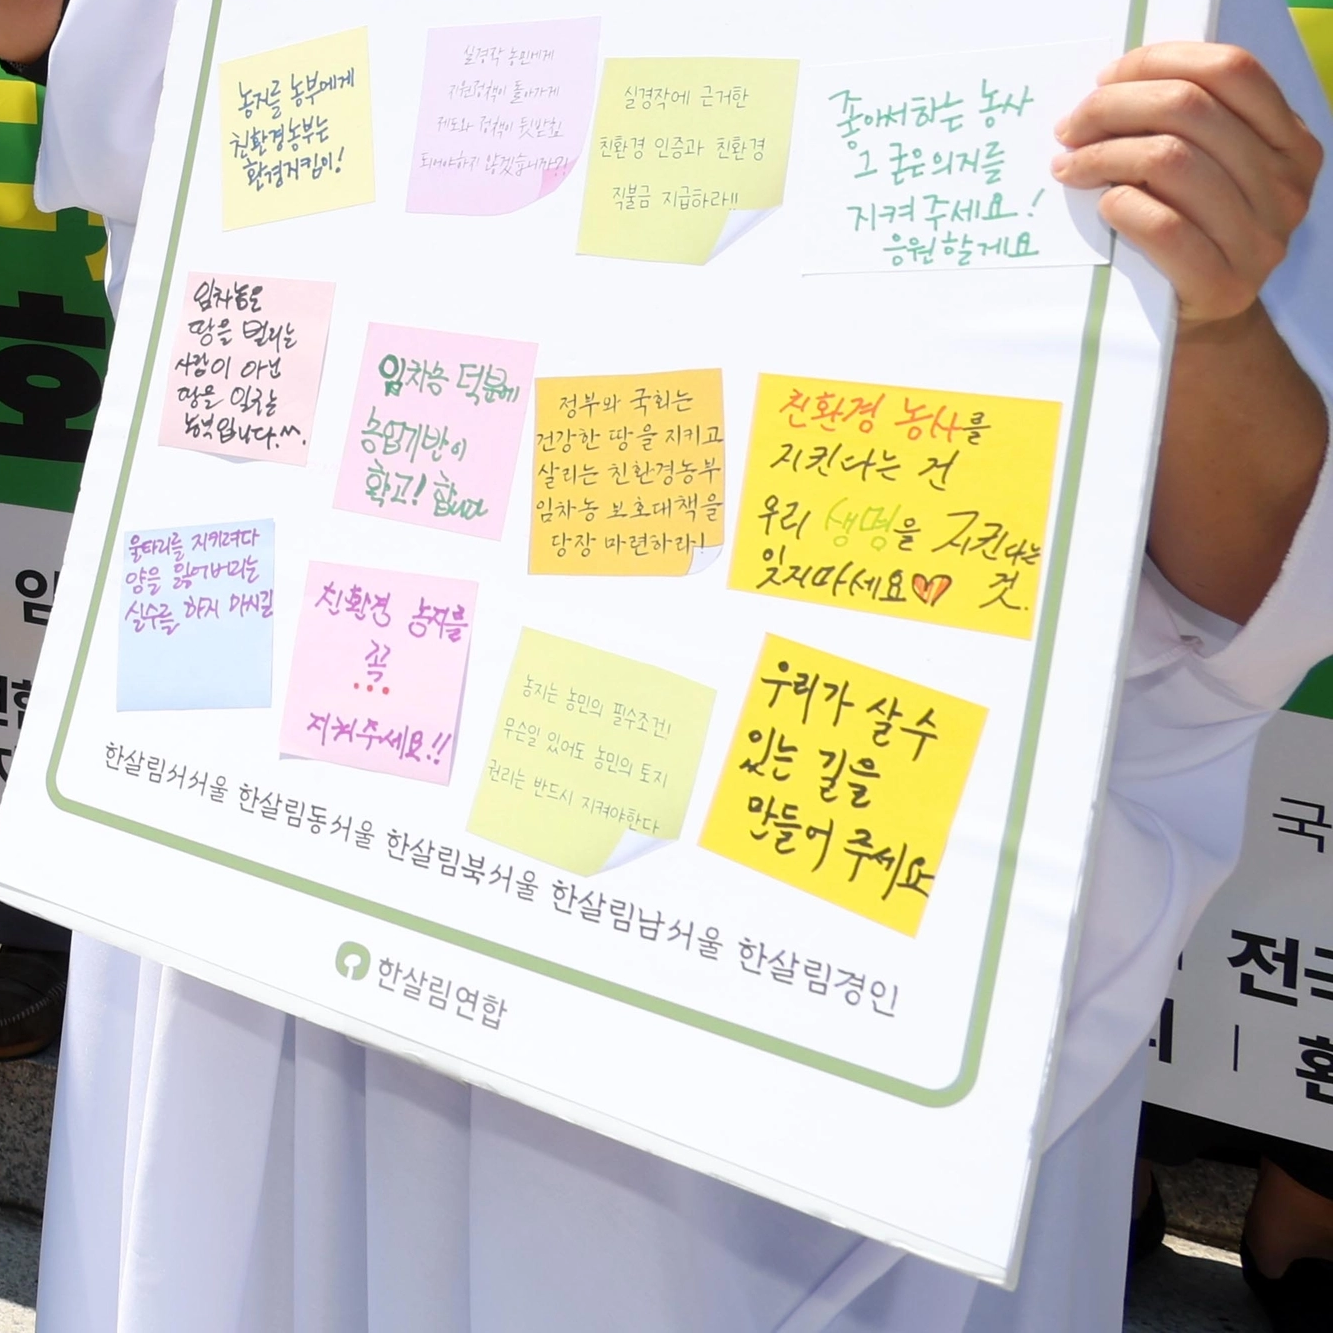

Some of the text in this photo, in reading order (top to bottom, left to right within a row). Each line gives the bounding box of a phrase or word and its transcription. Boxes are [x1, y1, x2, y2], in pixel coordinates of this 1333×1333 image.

[623, 85, 750, 110] 실경작에 근거한
[598, 135, 767, 162] 친환경 인증과 친환경
[612, 184, 651, 211] 직불금
[559, 389, 694, 416] 정부와 국회는
[779, 387, 992, 447] 친환경 농사를
[536, 425, 724, 452] 건강한 땅을 지키고
[538, 461, 600, 487] 살리는
[769, 440, 961, 493] 지킨다는 건
[536, 495, 724, 525] 임차농 보호대책을
[757, 493, 813, 541] 우리
[824, 496, 923, 553] 생명을
[550, 530, 707, 558] 당장 마련하라!
[522, 673, 561, 705] 농지는
[566, 685, 603, 718] 농민의
[759, 659, 856, 726] 우리가
[487, 759, 527, 791] 권리는
[533, 774, 575, 807] 반드시
[547, 731, 586, 763] 있어도
[594, 741, 634, 778] 농민의
[639, 756, 668, 789] 토지
[738, 725, 882, 808] 있는 길을
[747, 794, 935, 902] 만들어 주세요
[105, 742, 899, 1018] 한살림서서울 한살림동서울 한살림북서울 한살림남서울 한살림경인
[378, 957, 509, 1030] 한살림연합
